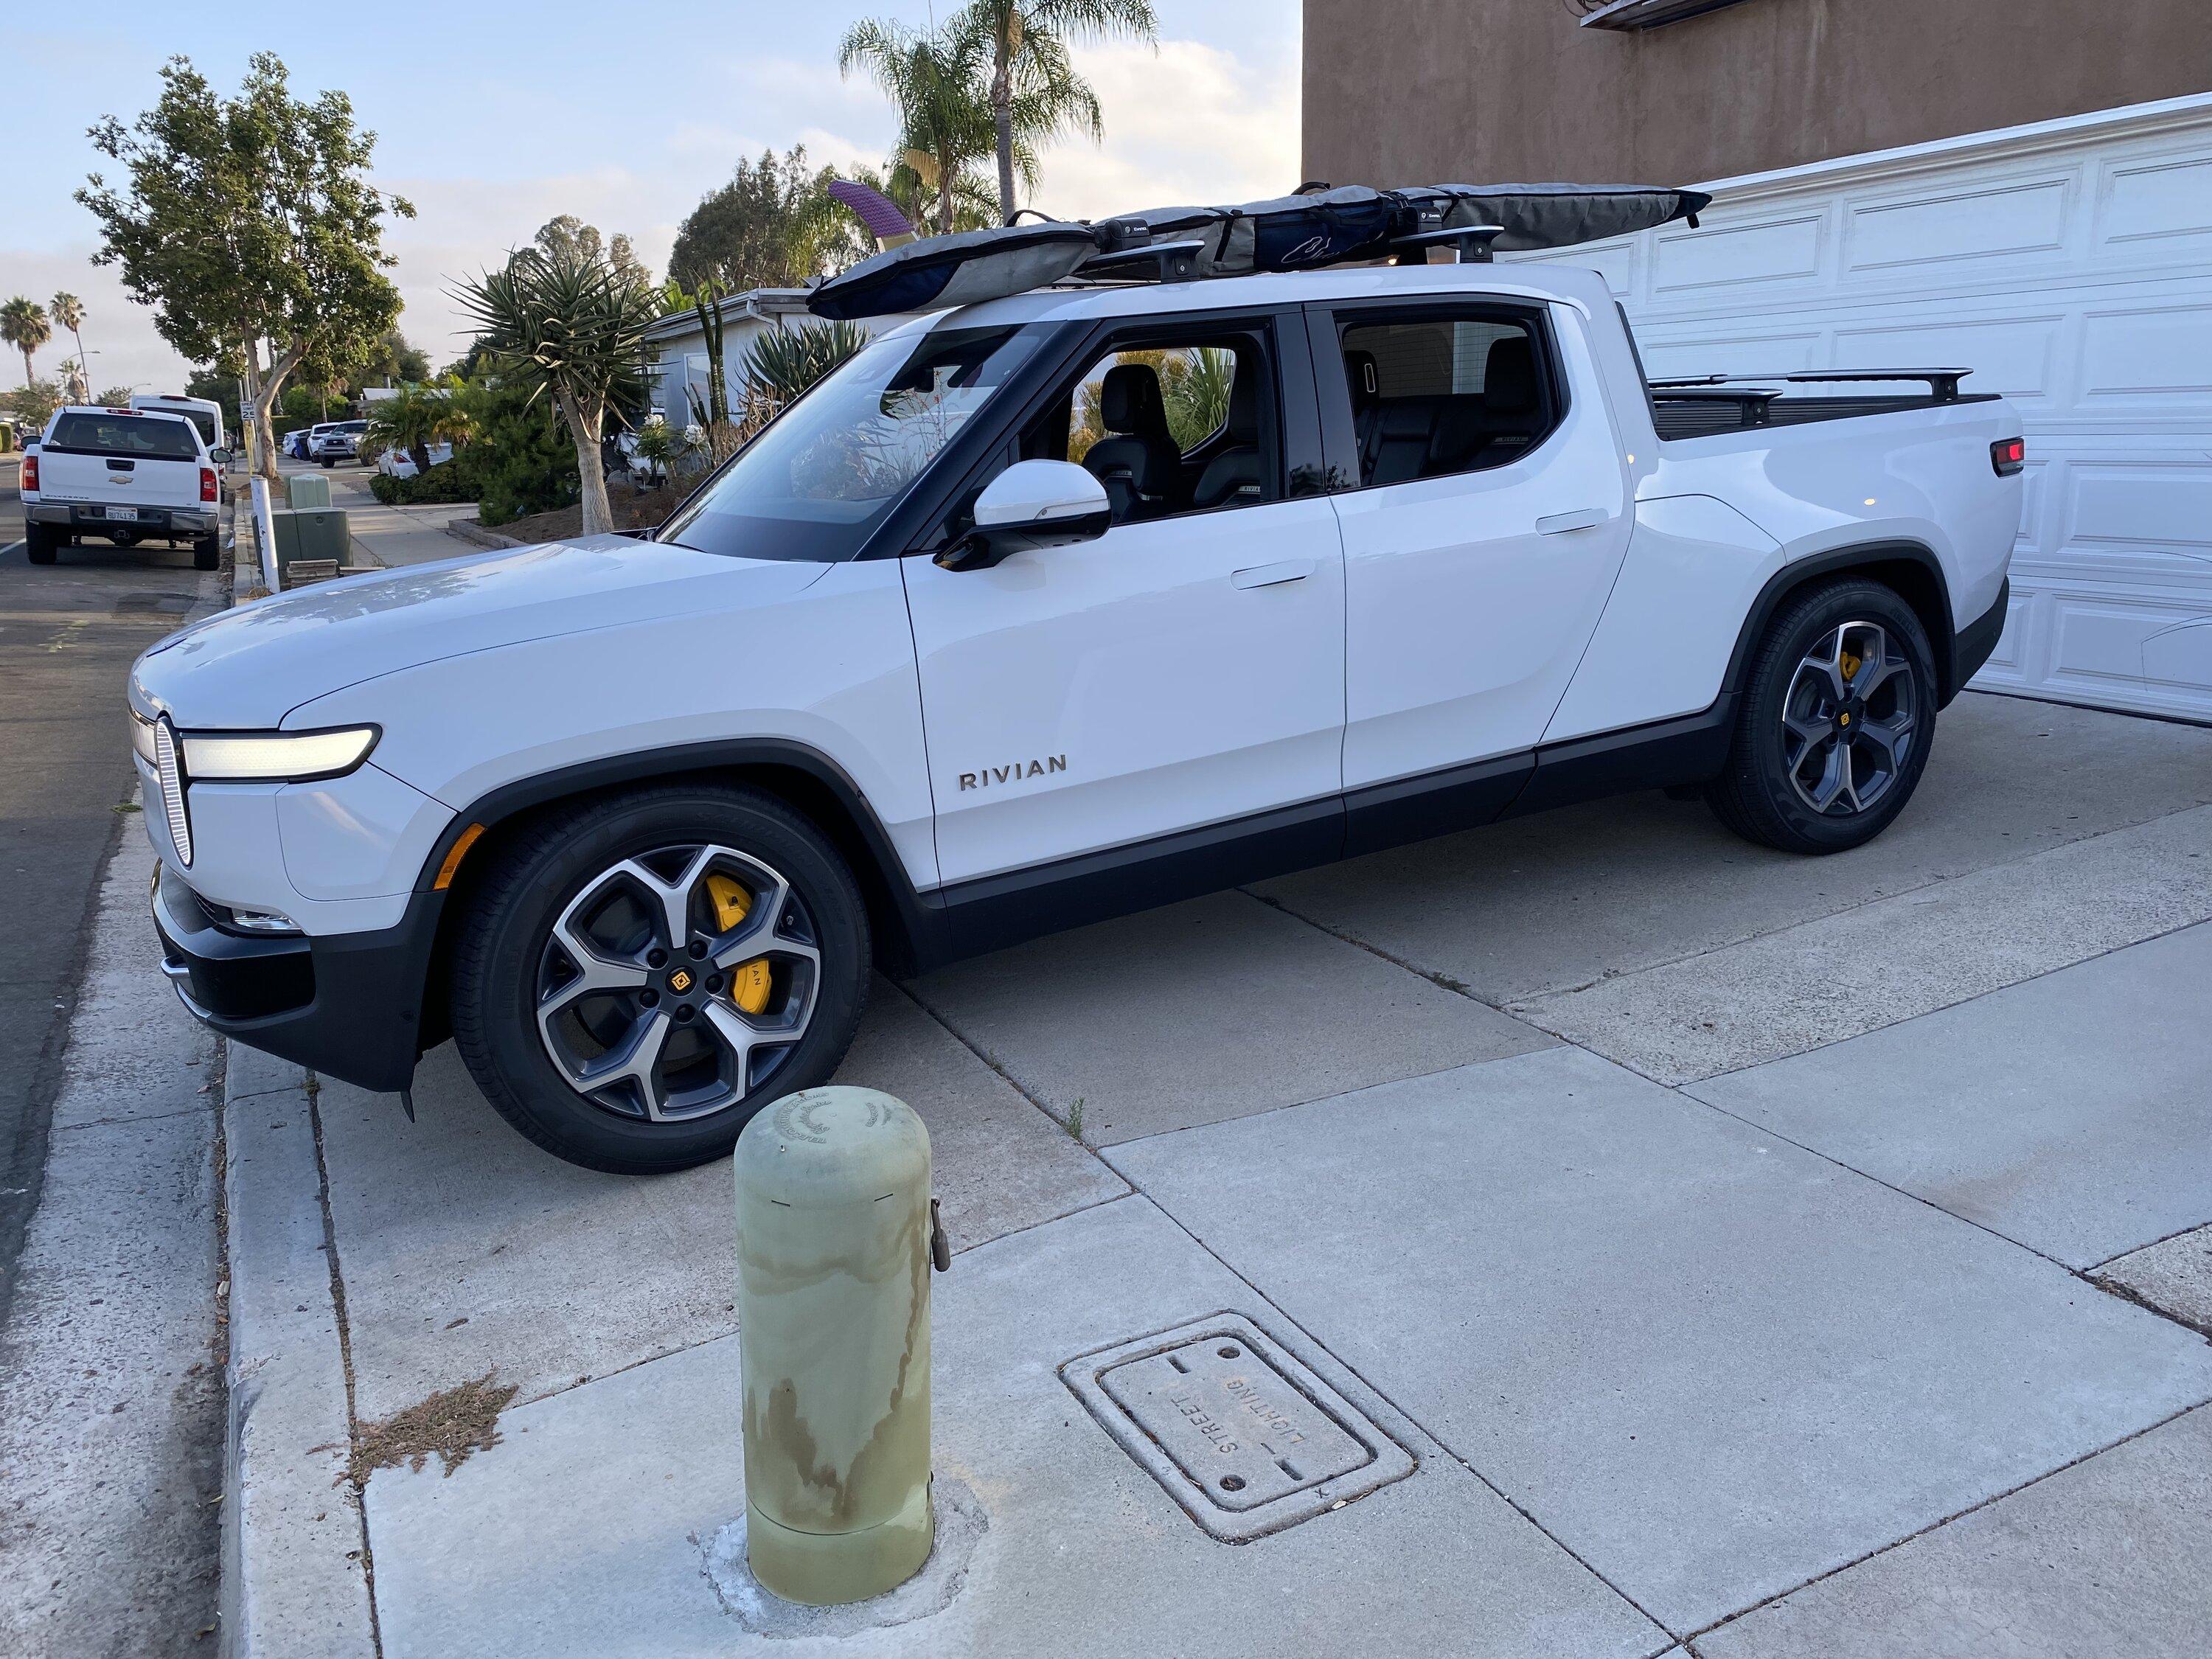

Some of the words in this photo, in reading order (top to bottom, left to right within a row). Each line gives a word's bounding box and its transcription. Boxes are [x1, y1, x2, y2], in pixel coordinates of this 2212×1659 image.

[243, 411, 255, 419] 25
[959, 754, 1066, 791] RIVIAN
[752, 964, 761, 986] IAN
[1171, 1396, 1238, 1453] STREET
[1227, 1380, 1307, 1444] LIGHTING
